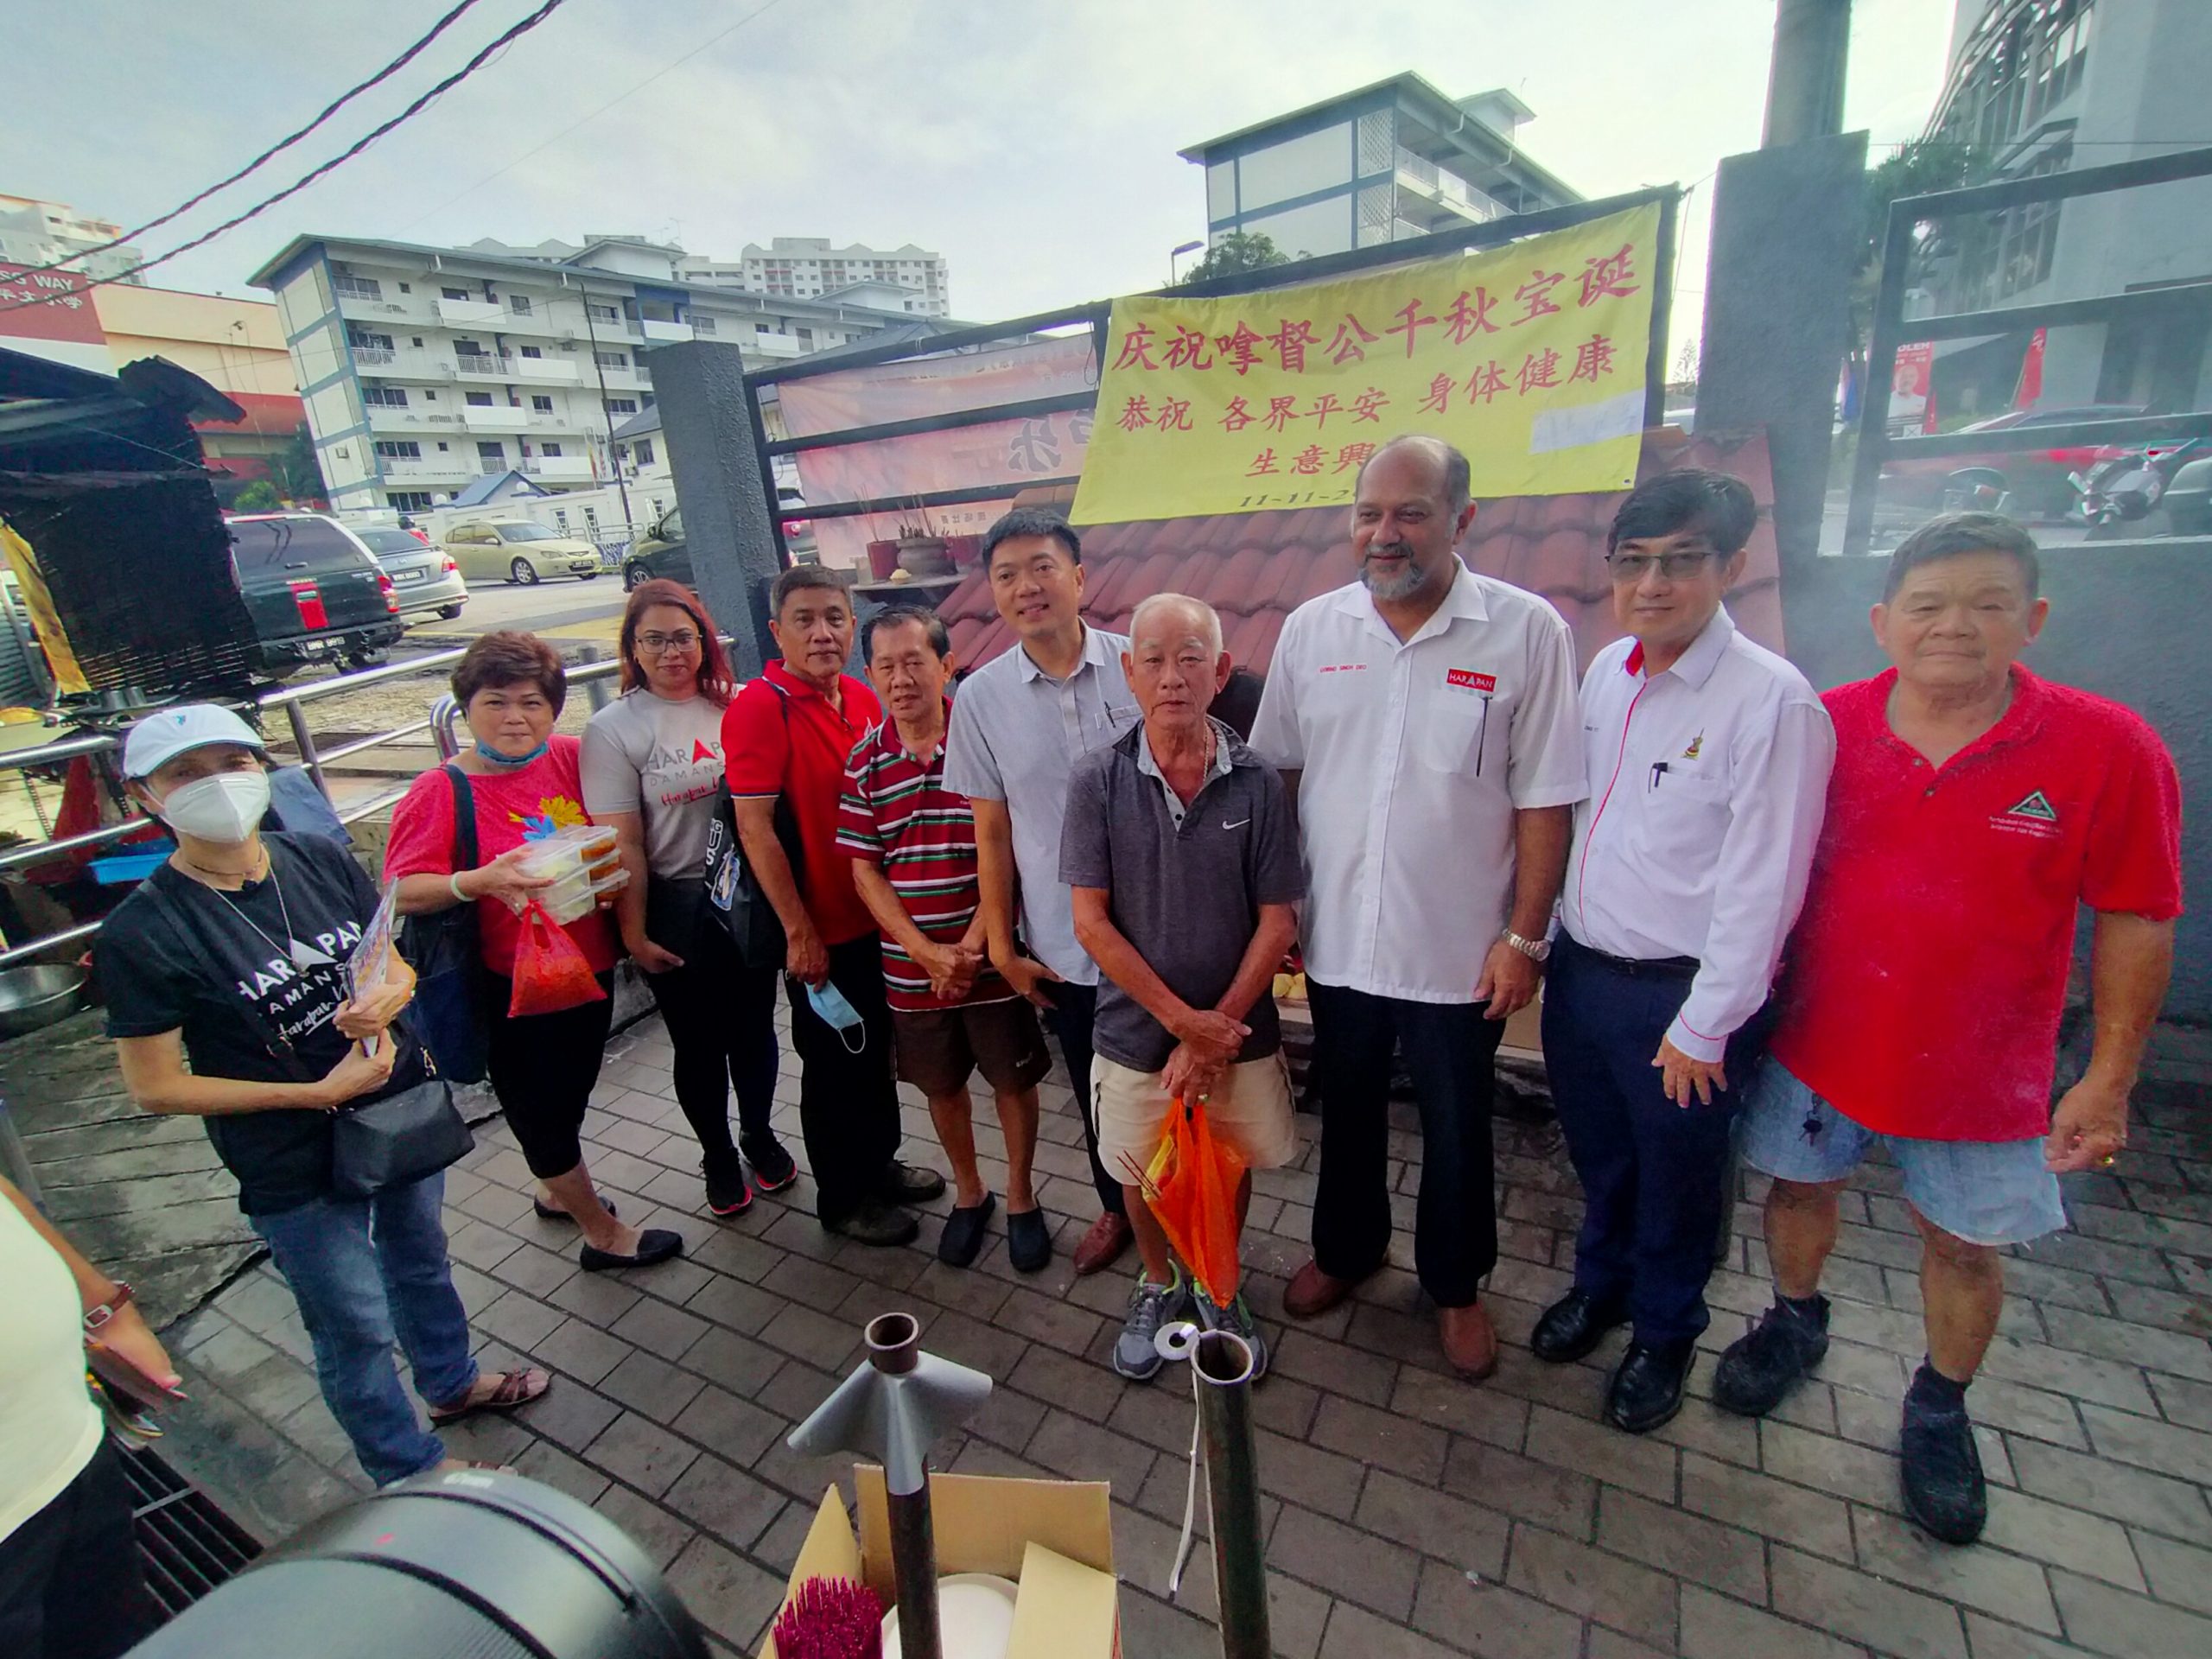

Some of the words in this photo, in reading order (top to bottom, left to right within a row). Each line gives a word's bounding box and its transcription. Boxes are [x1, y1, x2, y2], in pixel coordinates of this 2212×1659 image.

[33, 274, 73, 291] WAY
[1115, 395, 1193, 432] 恭祝
[1217, 385, 1390, 434] 各界平安
[1416, 333, 1618, 415] 身体健康
[1239, 489, 1357, 507] 11-11-2
